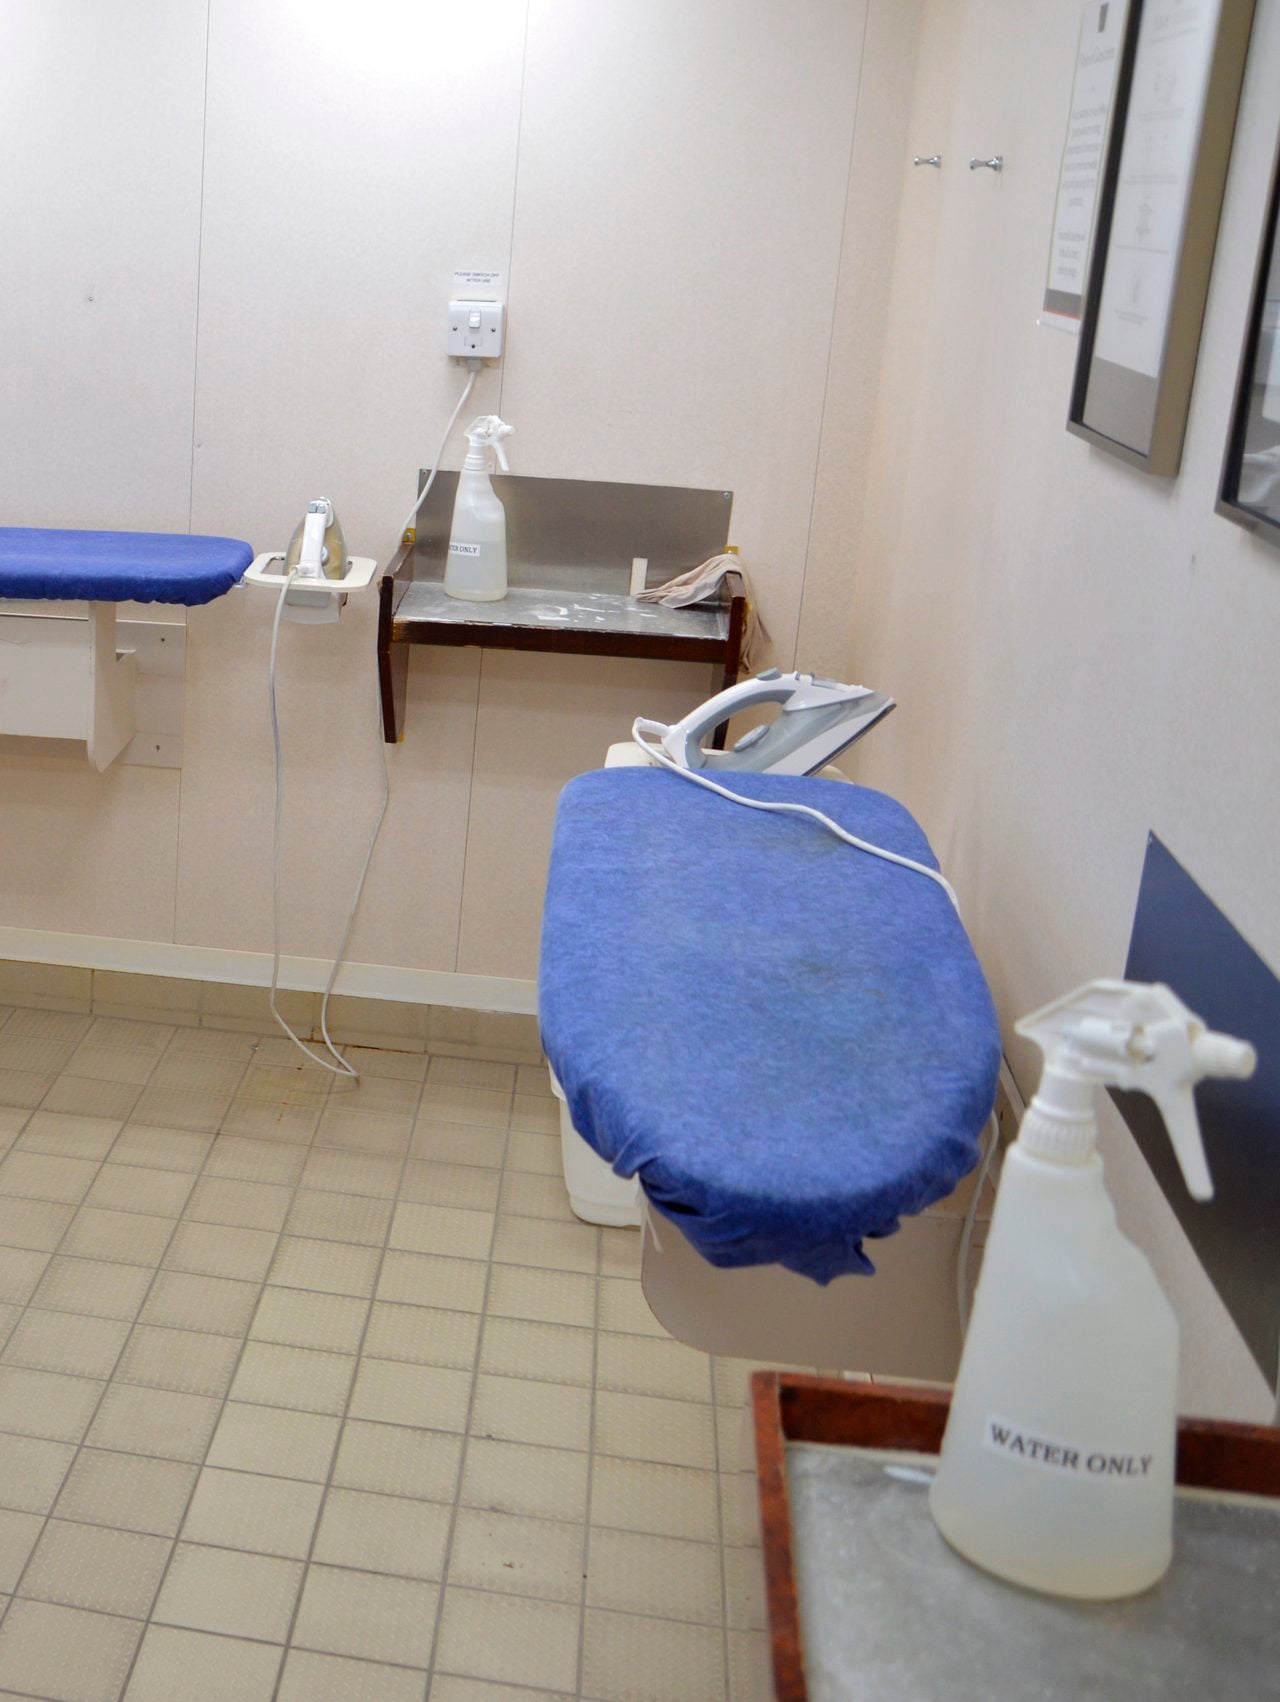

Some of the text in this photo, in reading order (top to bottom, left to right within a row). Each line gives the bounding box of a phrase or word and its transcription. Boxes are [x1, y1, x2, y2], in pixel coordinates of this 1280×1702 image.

[460, 546, 478, 554] ONLY
[990, 1422, 1153, 1476] WATER ONLY
